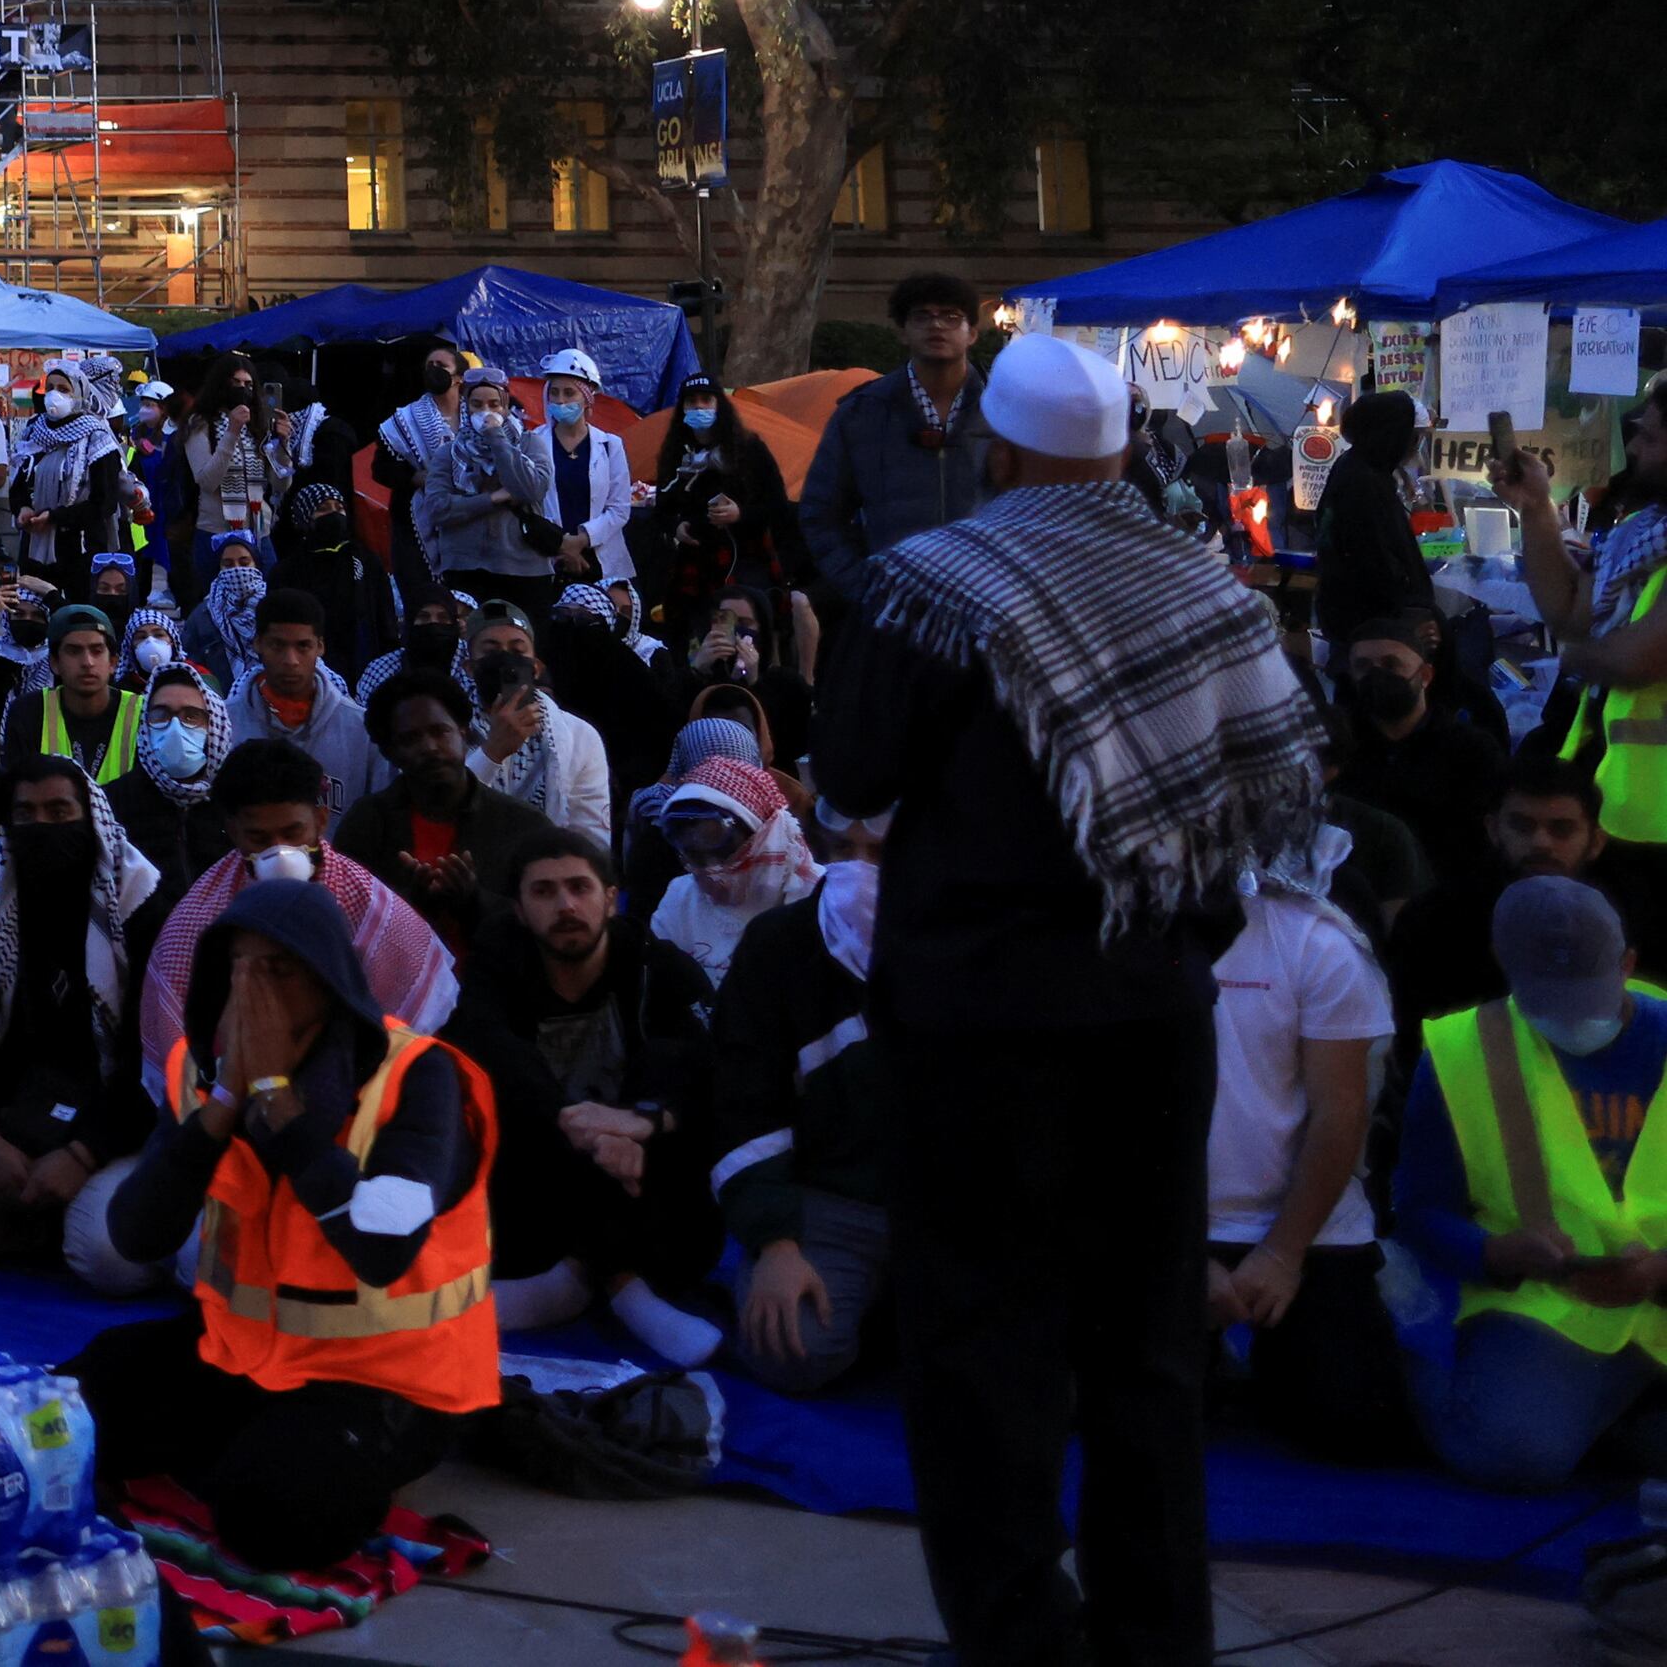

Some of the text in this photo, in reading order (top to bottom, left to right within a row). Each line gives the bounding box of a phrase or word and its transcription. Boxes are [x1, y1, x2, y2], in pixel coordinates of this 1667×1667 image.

[657, 80, 683, 103] UCLA
[657, 116, 681, 147] GO
[1579, 315, 1597, 333] EYE
[1382, 333, 1421, 348] EXIST
[1576, 341, 1634, 357] IRRIGATION
[1128, 340, 1204, 384] MEDIC
